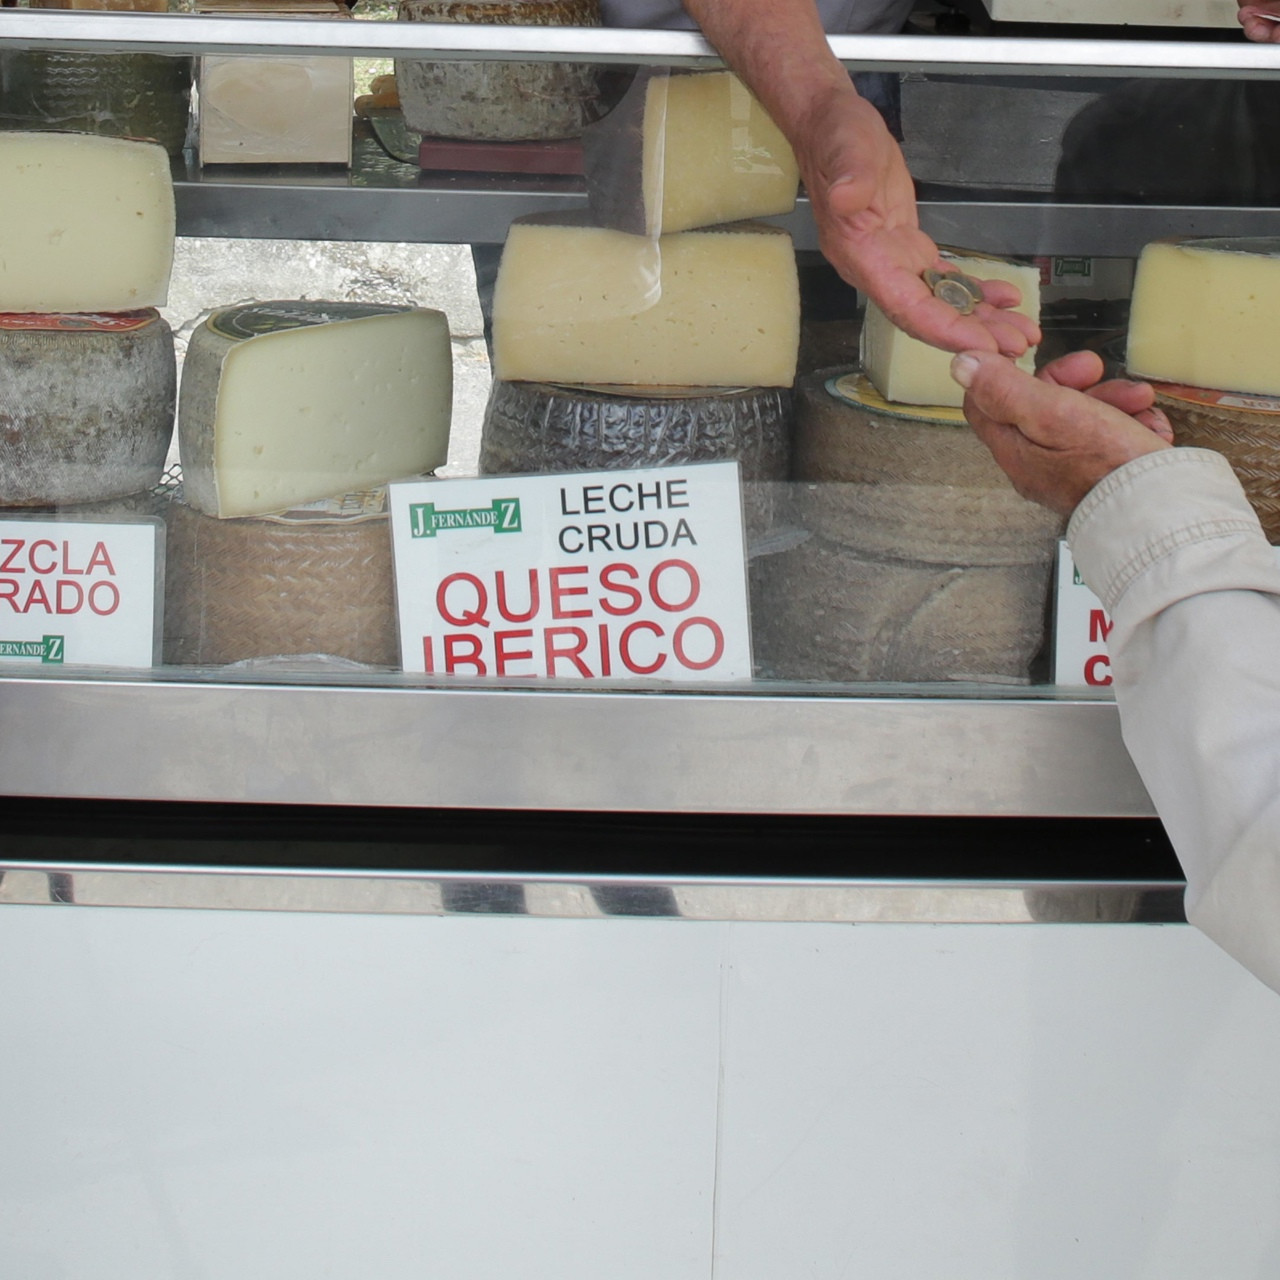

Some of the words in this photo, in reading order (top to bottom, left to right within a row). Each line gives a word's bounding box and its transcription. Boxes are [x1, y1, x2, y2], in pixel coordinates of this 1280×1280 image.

[559, 478, 691, 517] LECHE
[558, 517, 698, 554] CRUDA
[435, 558, 702, 629] QUESO
[422, 616, 726, 680] IBERICO
